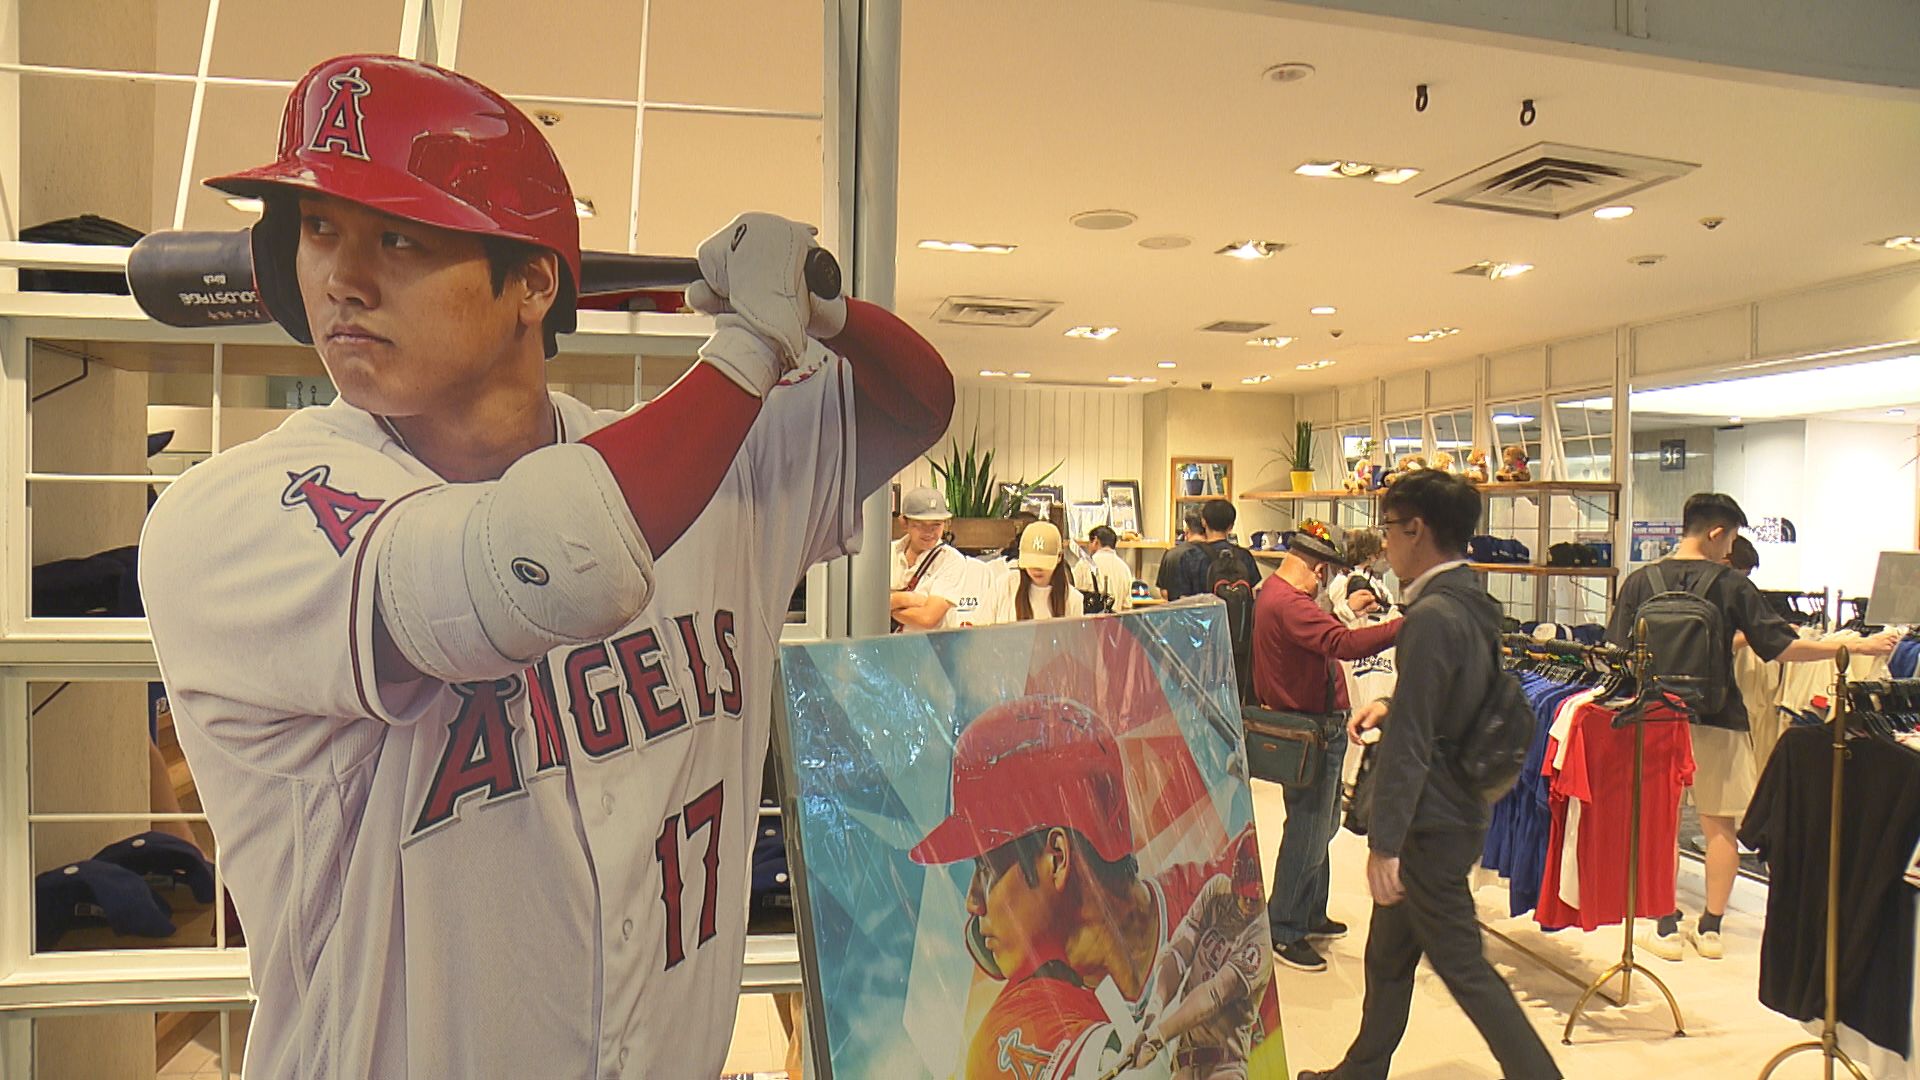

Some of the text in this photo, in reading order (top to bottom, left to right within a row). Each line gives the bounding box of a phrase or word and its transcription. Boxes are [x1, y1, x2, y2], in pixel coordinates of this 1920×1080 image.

[1660, 446, 1681, 466] 3F
[402, 608, 742, 849] ANGELS
[655, 779, 725, 973] 17
